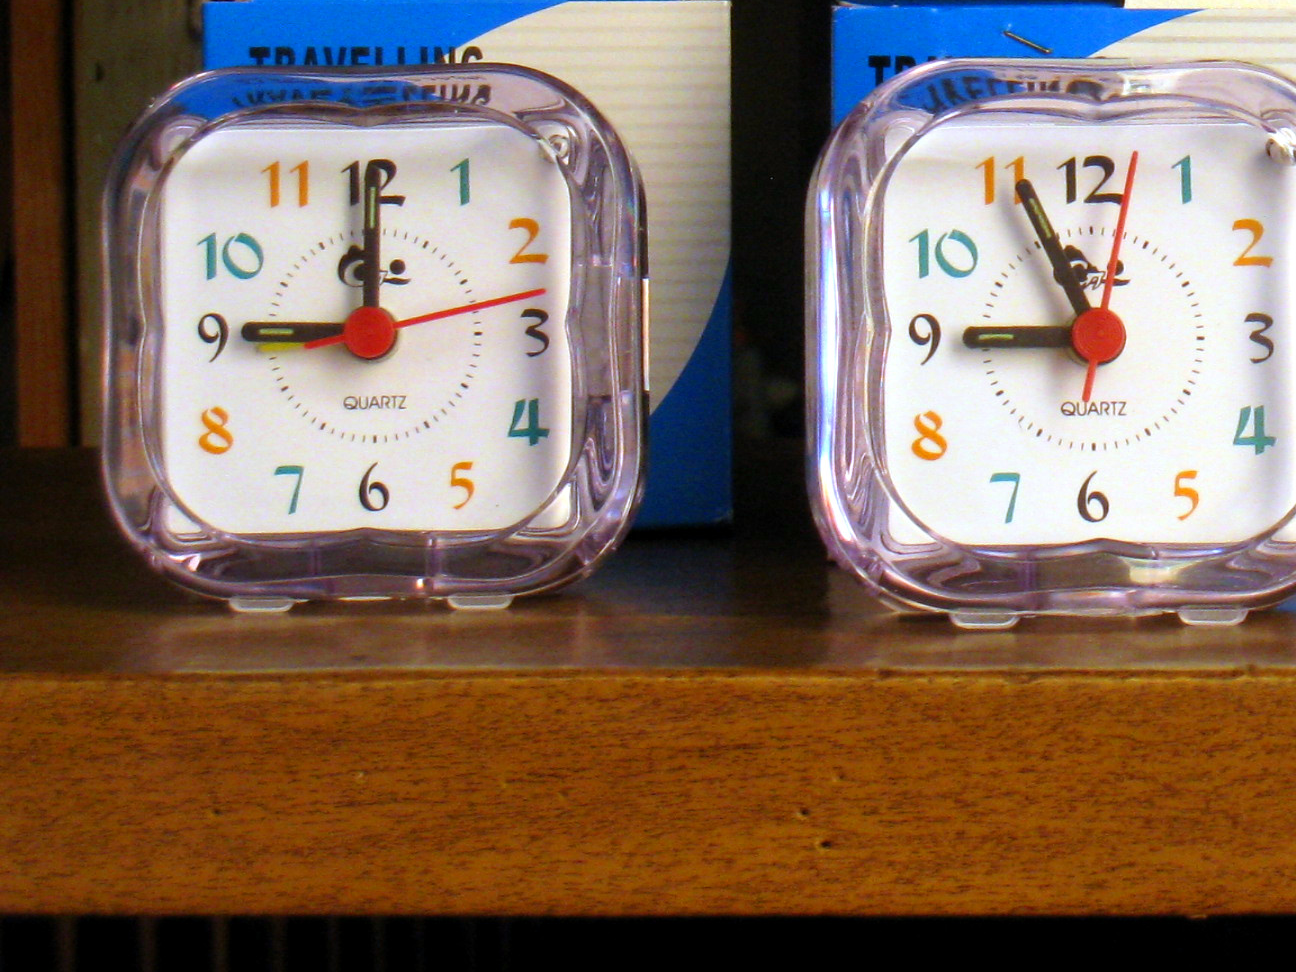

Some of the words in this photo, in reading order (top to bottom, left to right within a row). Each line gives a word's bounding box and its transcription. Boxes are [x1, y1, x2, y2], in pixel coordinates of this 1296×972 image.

[261, 160, 310, 208] 11
[450, 158, 471, 205] 1
[1056, 155, 1124, 204] 12
[1171, 155, 1192, 204] 1
[196, 232, 264, 280] 10
[508, 217, 549, 264] 2
[909, 228, 978, 278] 10
[1232, 219, 1273, 268] 2
[198, 312, 229, 363] 9
[521, 308, 550, 357] 3
[909, 312, 941, 365] 9
[1244, 312, 1274, 364] 3
[343, 394, 407, 411] QUARTZ
[508, 398, 550, 446] 4
[1061, 401, 1127, 418] QUARTZ
[198, 406, 234, 454] 8
[911, 410, 948, 461] 8
[1233, 405, 1276, 455] 4
[274, 465, 304, 515] 7
[358, 462, 390, 512] 6
[450, 461, 474, 510] 5
[989, 472, 1021, 524] 7
[1077, 471, 1109, 523] 6
[1173, 470, 1200, 521] 5
